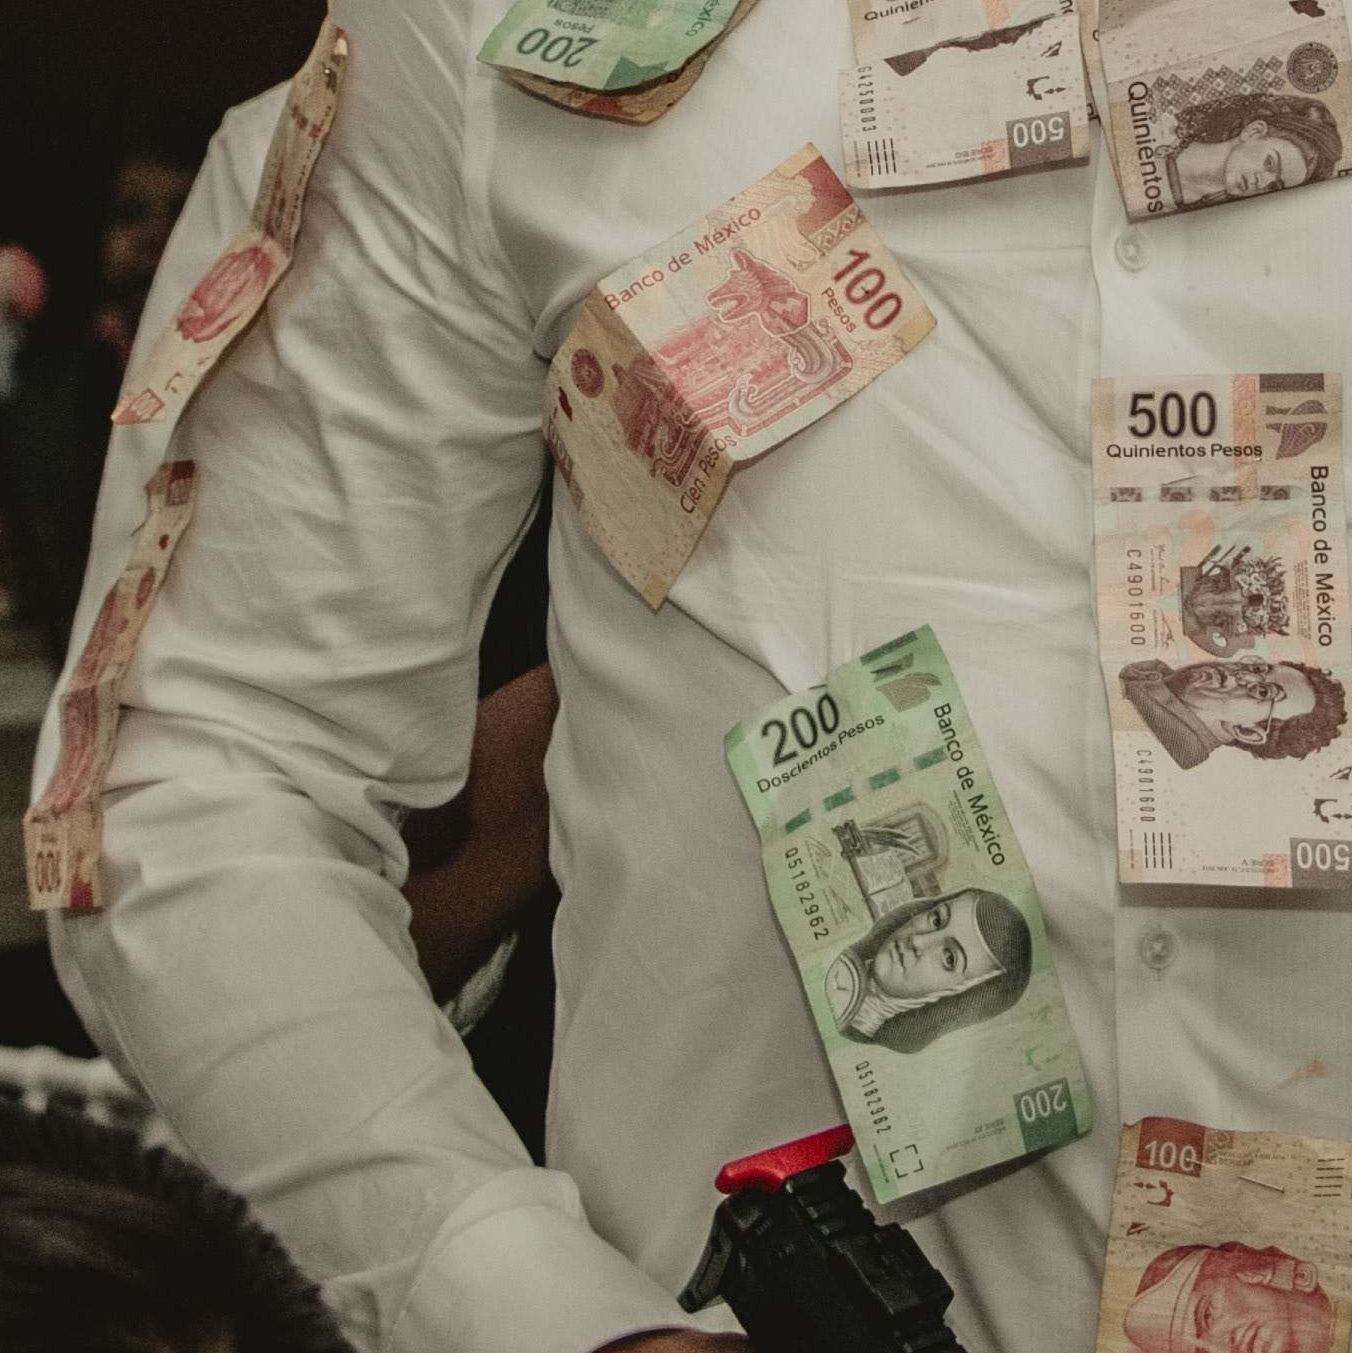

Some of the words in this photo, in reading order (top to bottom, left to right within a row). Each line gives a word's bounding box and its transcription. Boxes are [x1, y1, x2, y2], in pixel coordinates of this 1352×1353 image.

[516, 28, 601, 68] 200
[1013, 116, 1065, 148] 500
[1126, 81, 1165, 214] Quinientos
[604, 268, 665, 310] Banco
[668, 252, 693, 273] de
[693, 208, 762, 255] México
[834, 249, 903, 330] 100
[821, 286, 857, 334] Pesos
[1127, 390, 1218, 439] 500
[680, 477, 706, 515] Cien
[699, 435, 738, 478] Pesos
[1107, 443, 1207, 460] Quinientos
[1210, 443, 1263, 459] Pesos
[1310, 464, 1330, 534] Banco
[1313, 542, 1333, 565] de
[1126, 549, 1146, 646] C4901600
[1314, 576, 1333, 648] México
[756, 740, 839, 794] Doscientos
[837, 713, 886, 746] Pesos
[760, 693, 840, 768] 200
[934, 702, 964, 764] Banco
[956, 766, 975, 791] de
[968, 794, 1006, 867] México
[1135, 748, 1156, 823] C4901600
[1296, 840, 1351, 871] 500
[1020, 1082, 1067, 1123] 200
[1143, 1139, 1196, 1172] 100
